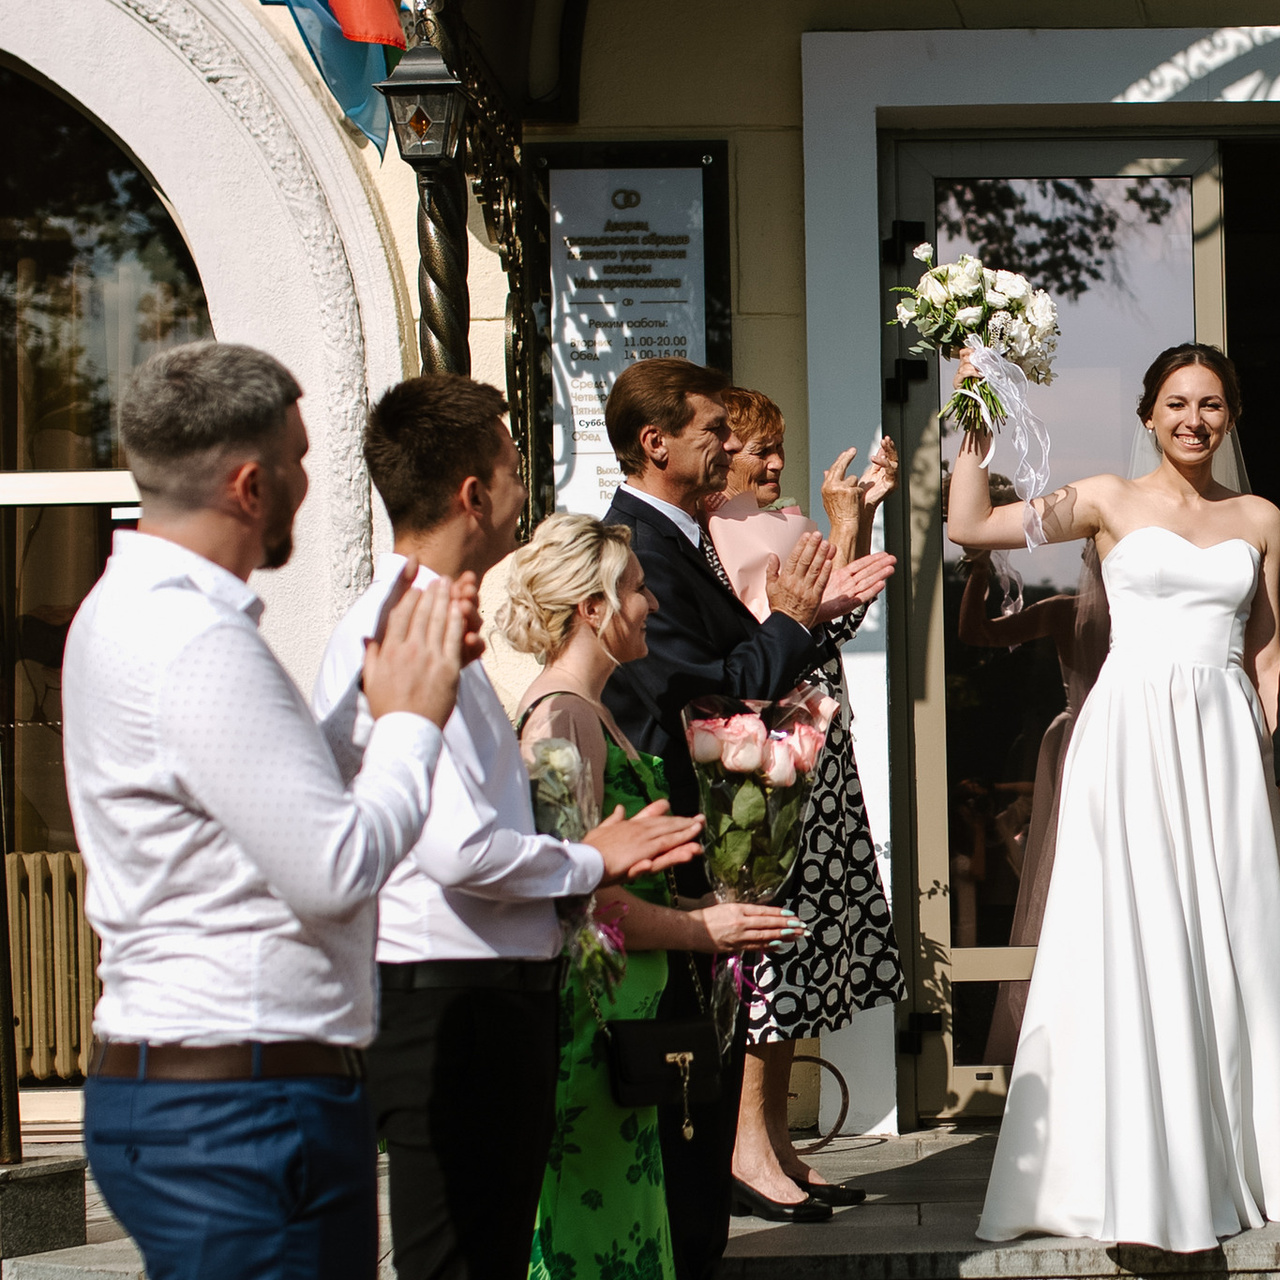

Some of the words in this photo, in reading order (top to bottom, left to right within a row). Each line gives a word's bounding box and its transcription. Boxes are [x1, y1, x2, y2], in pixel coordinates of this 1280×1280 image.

[589, 318, 623, 329] Режим
[626, 317, 668, 329] работы:
[570, 338, 612, 350] Вторник
[624, 336, 687, 347] 11.00-20.00
[570, 350, 600, 362] Обед
[624, 349, 687, 360] 14.00-1500
[570, 379, 607, 391] Среда
[570, 392, 609, 404] Четвер
[579, 419, 606, 429] Суббо
[571, 431, 601, 442] Обед
